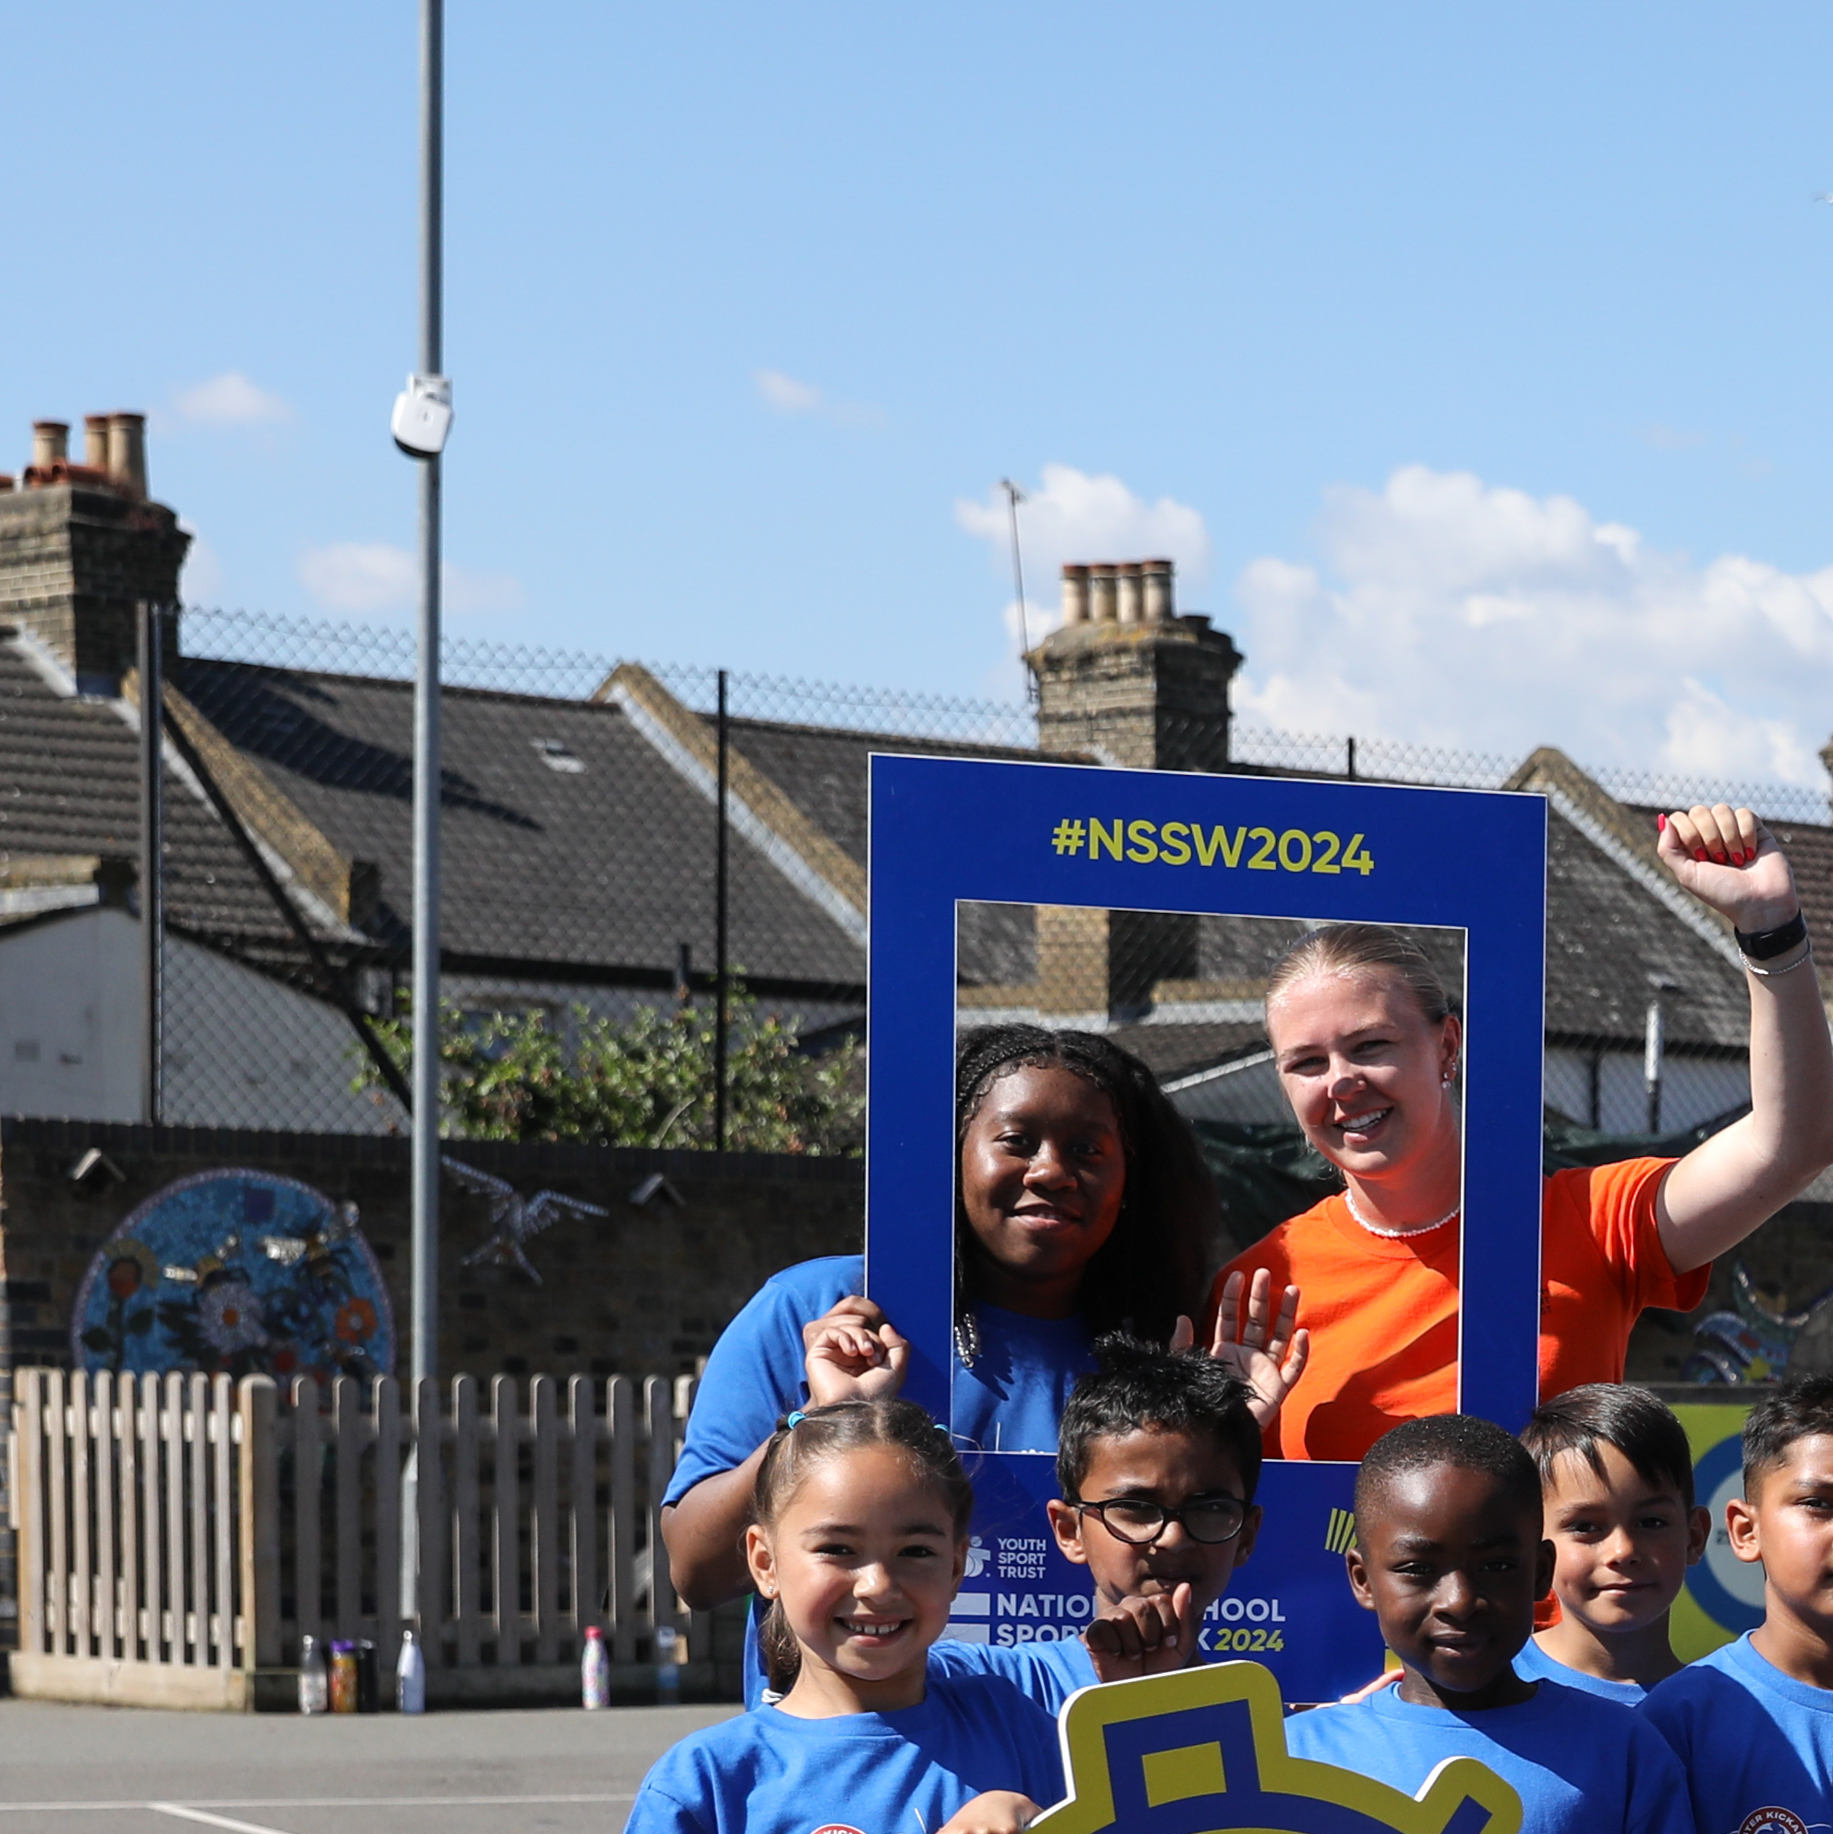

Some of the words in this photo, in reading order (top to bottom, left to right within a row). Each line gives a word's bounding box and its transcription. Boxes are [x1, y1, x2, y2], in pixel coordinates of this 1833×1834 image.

[1052, 817, 1375, 875] #NSSW2024
[997, 1538, 1047, 1551] YOUTH
[998, 1552, 1047, 1566] SPORT
[998, 1566, 1047, 1579] TRUST
[997, 1594, 1098, 1618] NATIO
[1214, 1629, 1285, 1652] 2024
